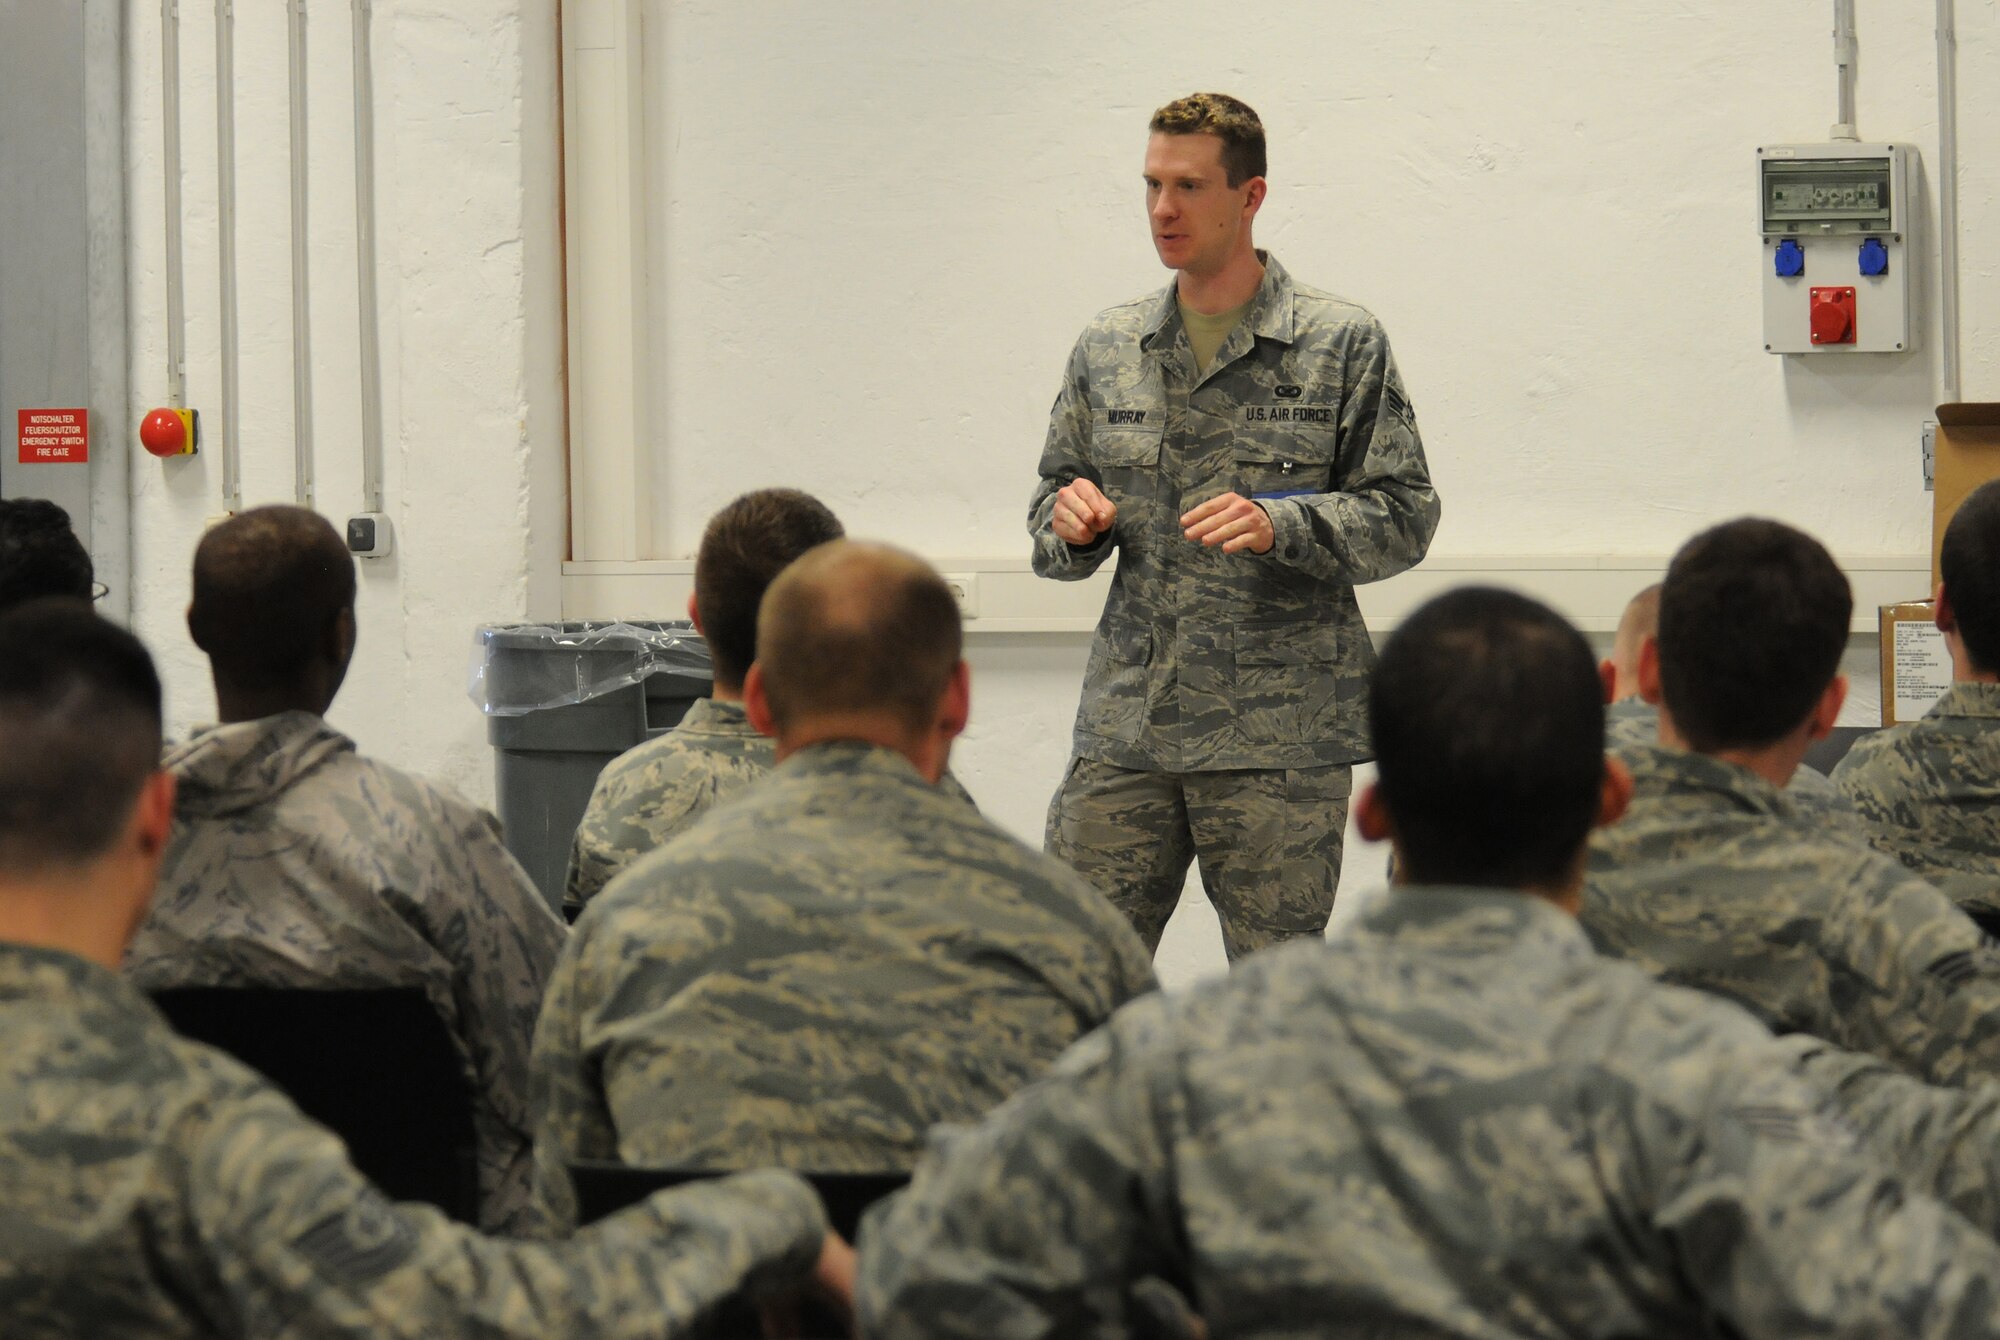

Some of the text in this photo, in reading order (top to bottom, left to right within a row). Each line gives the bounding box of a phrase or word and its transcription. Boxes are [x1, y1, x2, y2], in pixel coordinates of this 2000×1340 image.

[1107, 410, 1147, 424] MURRAY
[1246, 407, 1332, 422] U.S. AIR FORCE
[31, 415, 74, 424] NOTSCHALTER
[25, 426, 80, 435] FEUERSCHUTZTOR
[22, 437, 84, 446] EMERGENCY SWITCH
[37, 448, 69, 457] FIRE GATE
